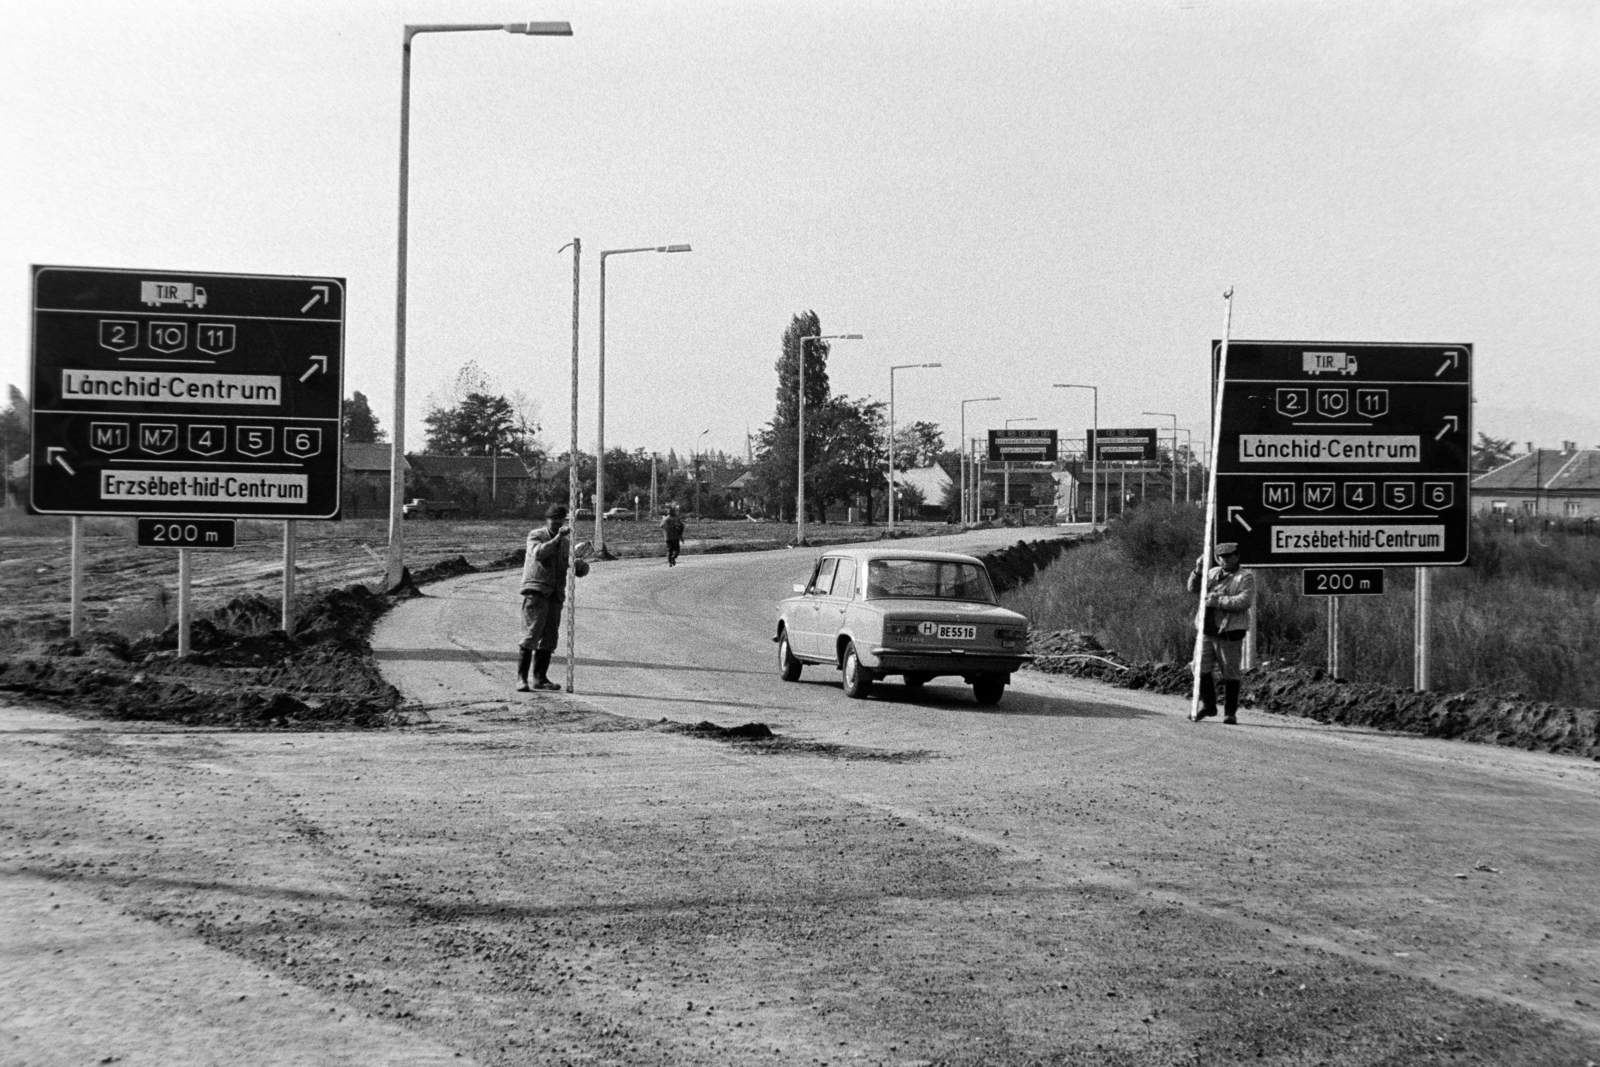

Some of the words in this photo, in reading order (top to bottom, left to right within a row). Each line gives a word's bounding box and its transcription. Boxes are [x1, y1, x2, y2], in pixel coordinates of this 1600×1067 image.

[112, 326, 125, 343] 2
[155, 328, 181, 344] 10
[207, 330, 224, 346] 11
[1286, 393, 1298, 409] 2
[1322, 394, 1344, 409] 10
[1365, 395, 1379, 410] 11
[96, 428, 121, 445] M1
[145, 429, 173, 446] M7
[198, 431, 212, 447] 4
[248, 432, 262, 448] 5
[295, 433, 310, 450] 6
[1268, 488, 1289, 503] M1
[1308, 488, 1332, 503] M7
[1352, 488, 1364, 502] 4
[1393, 488, 1405, 502] 5
[1433, 488, 1445, 502] 6
[153, 524, 197, 541] 200
[206, 531, 218, 542] m
[1317, 574, 1353, 590] 200
[1360, 579, 1370, 589] m
[923, 623, 932, 633] H
